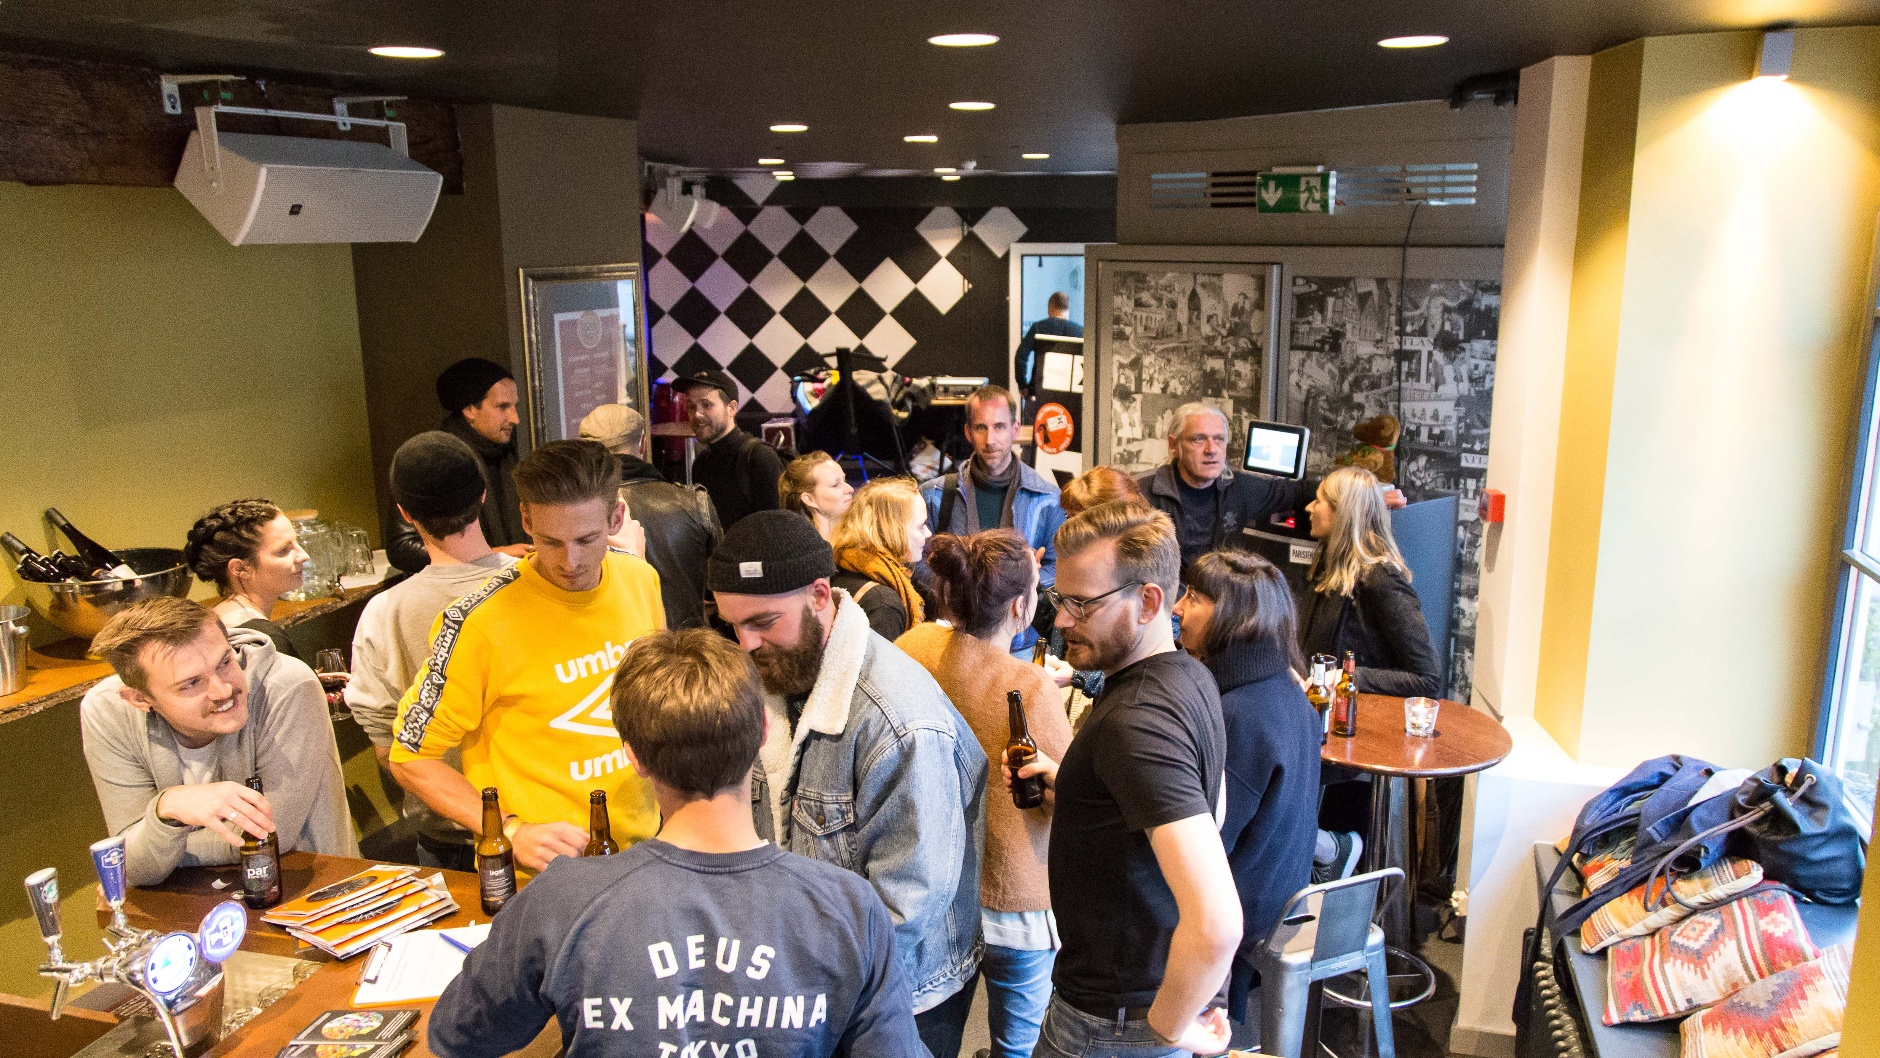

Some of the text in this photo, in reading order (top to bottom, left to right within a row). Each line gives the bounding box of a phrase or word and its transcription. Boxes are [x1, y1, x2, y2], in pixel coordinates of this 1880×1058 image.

[246, 865, 269, 879] par
[648, 934, 776, 981] DEUS
[583, 989, 827, 1031] EX MACHINA
